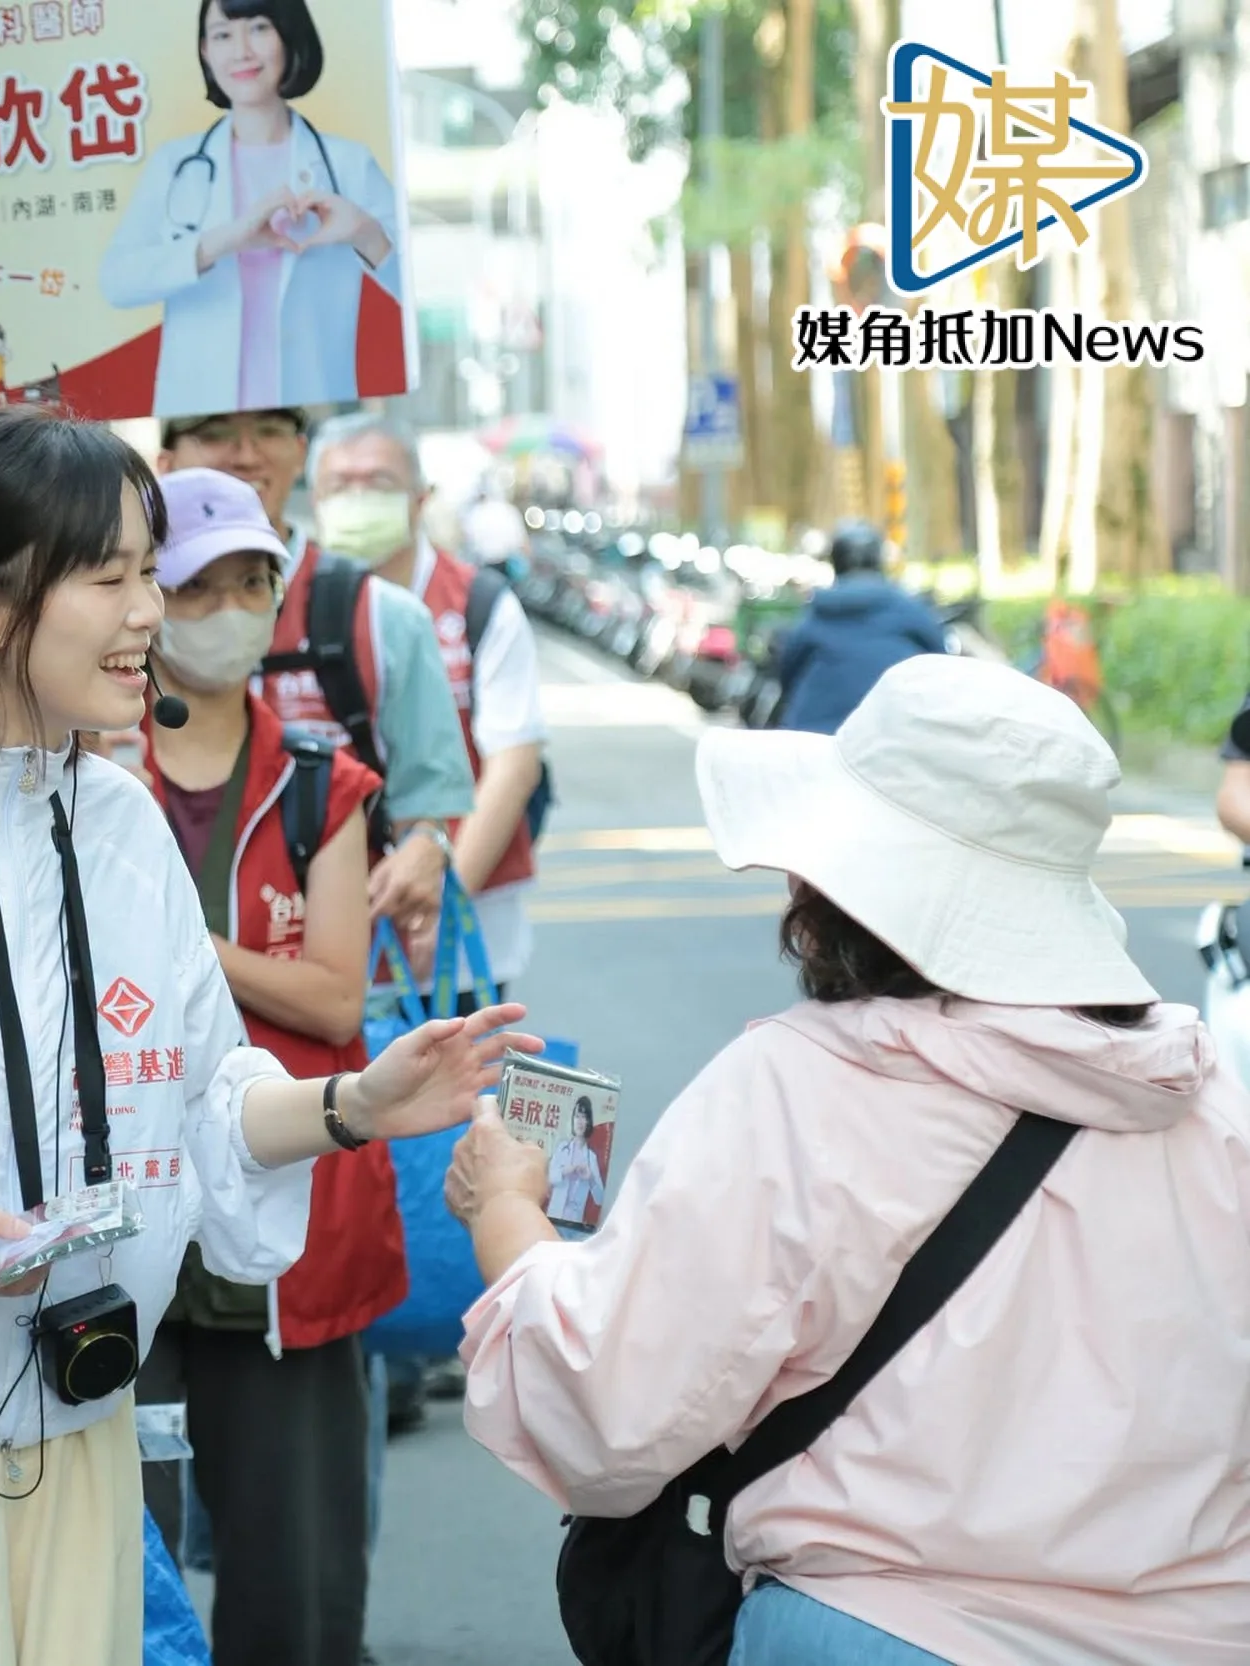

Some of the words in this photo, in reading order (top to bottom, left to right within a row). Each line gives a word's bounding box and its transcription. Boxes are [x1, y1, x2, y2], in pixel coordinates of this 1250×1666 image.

[72, 1047, 186, 1090] 灣基進
[117, 1157, 181, 1180] 北黨部
